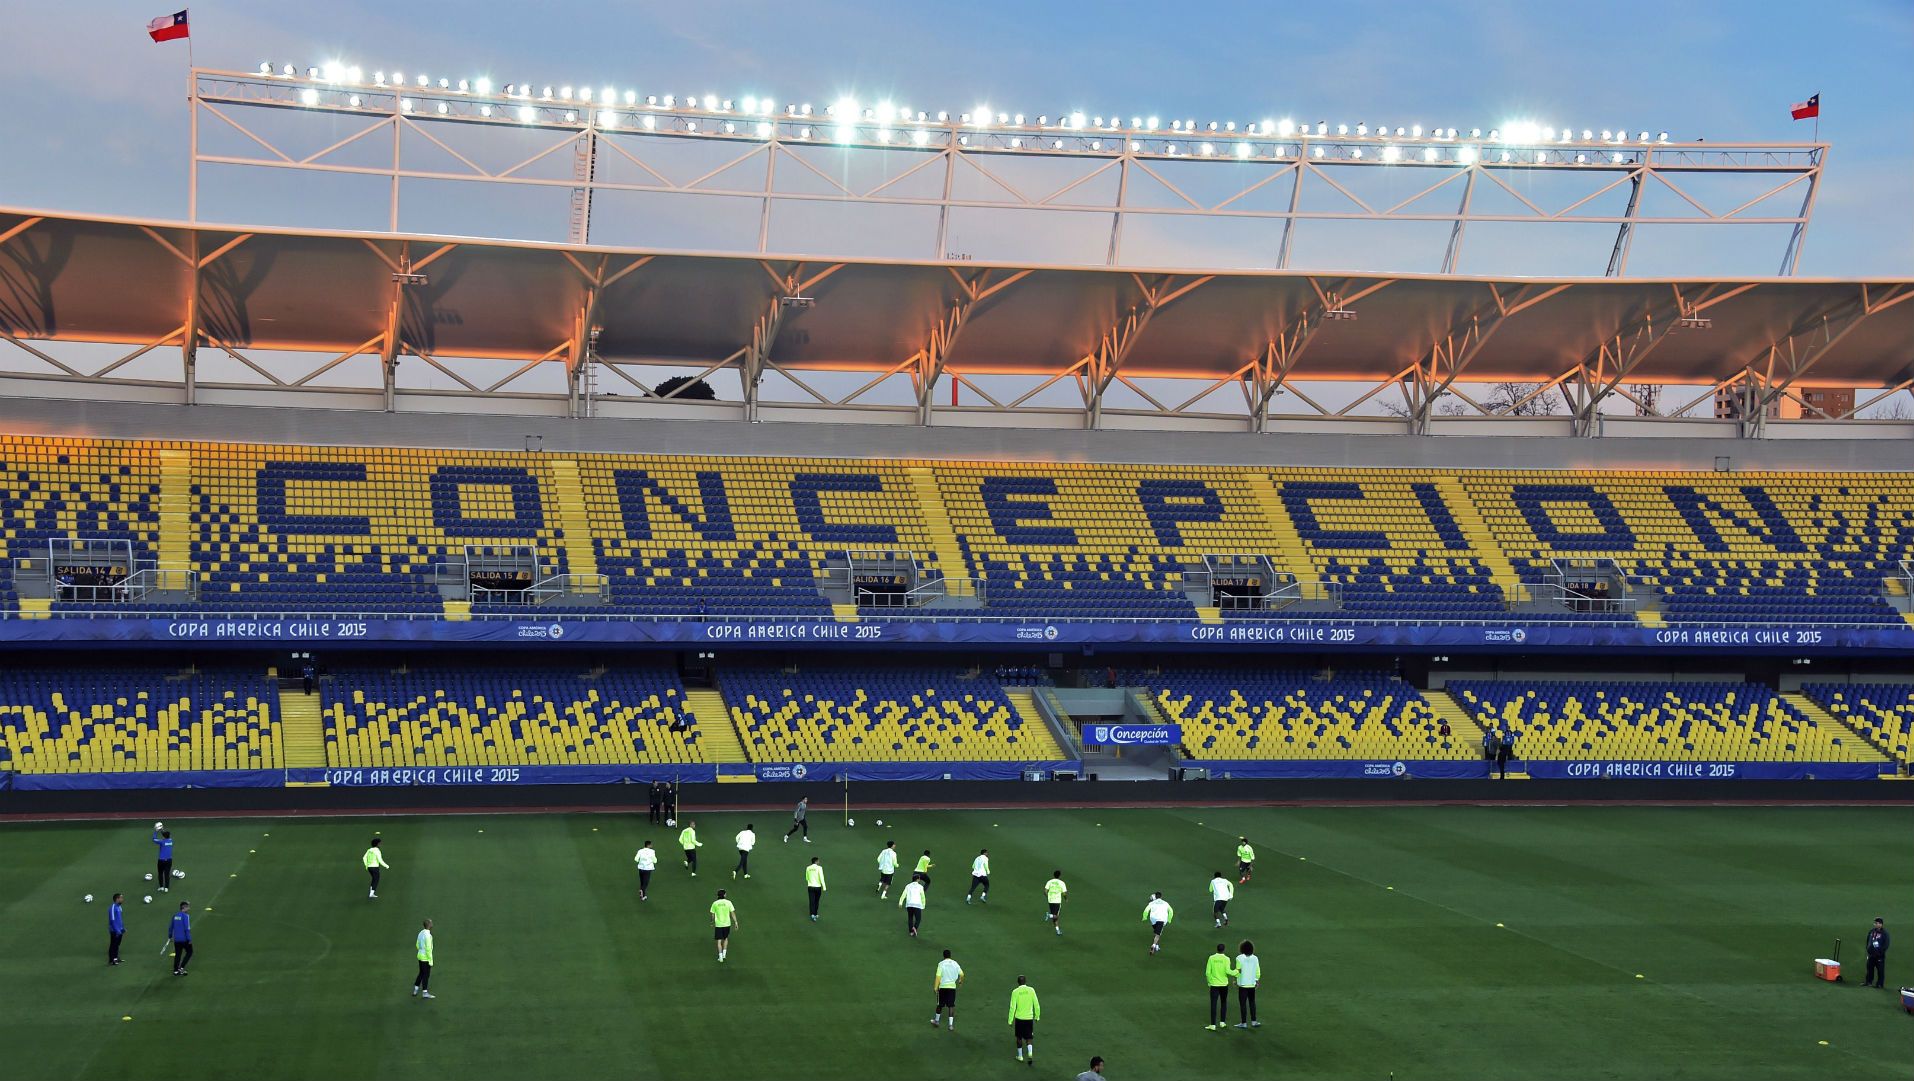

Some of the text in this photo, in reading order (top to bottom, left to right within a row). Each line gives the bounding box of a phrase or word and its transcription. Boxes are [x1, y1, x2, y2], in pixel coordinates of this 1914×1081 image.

[57, 566, 92, 574] SALIDA
[169, 623, 208, 637] COPA
[337, 623, 367, 636] 2015
[707, 625, 741, 638] COPA
[855, 625, 881, 639] 2015
[1191, 627, 1224, 640] COPA
[1330, 628, 1355, 641] 2015
[1656, 630, 1688, 643] COPA
[1796, 631, 1822, 643] 2015
[1109, 725, 1169, 744] Concepción
[323, 770, 362, 784] COPA
[491, 768, 520, 782] 2015
[1567, 763, 1600, 776] COPA
[1709, 764, 1735, 777] 2015
